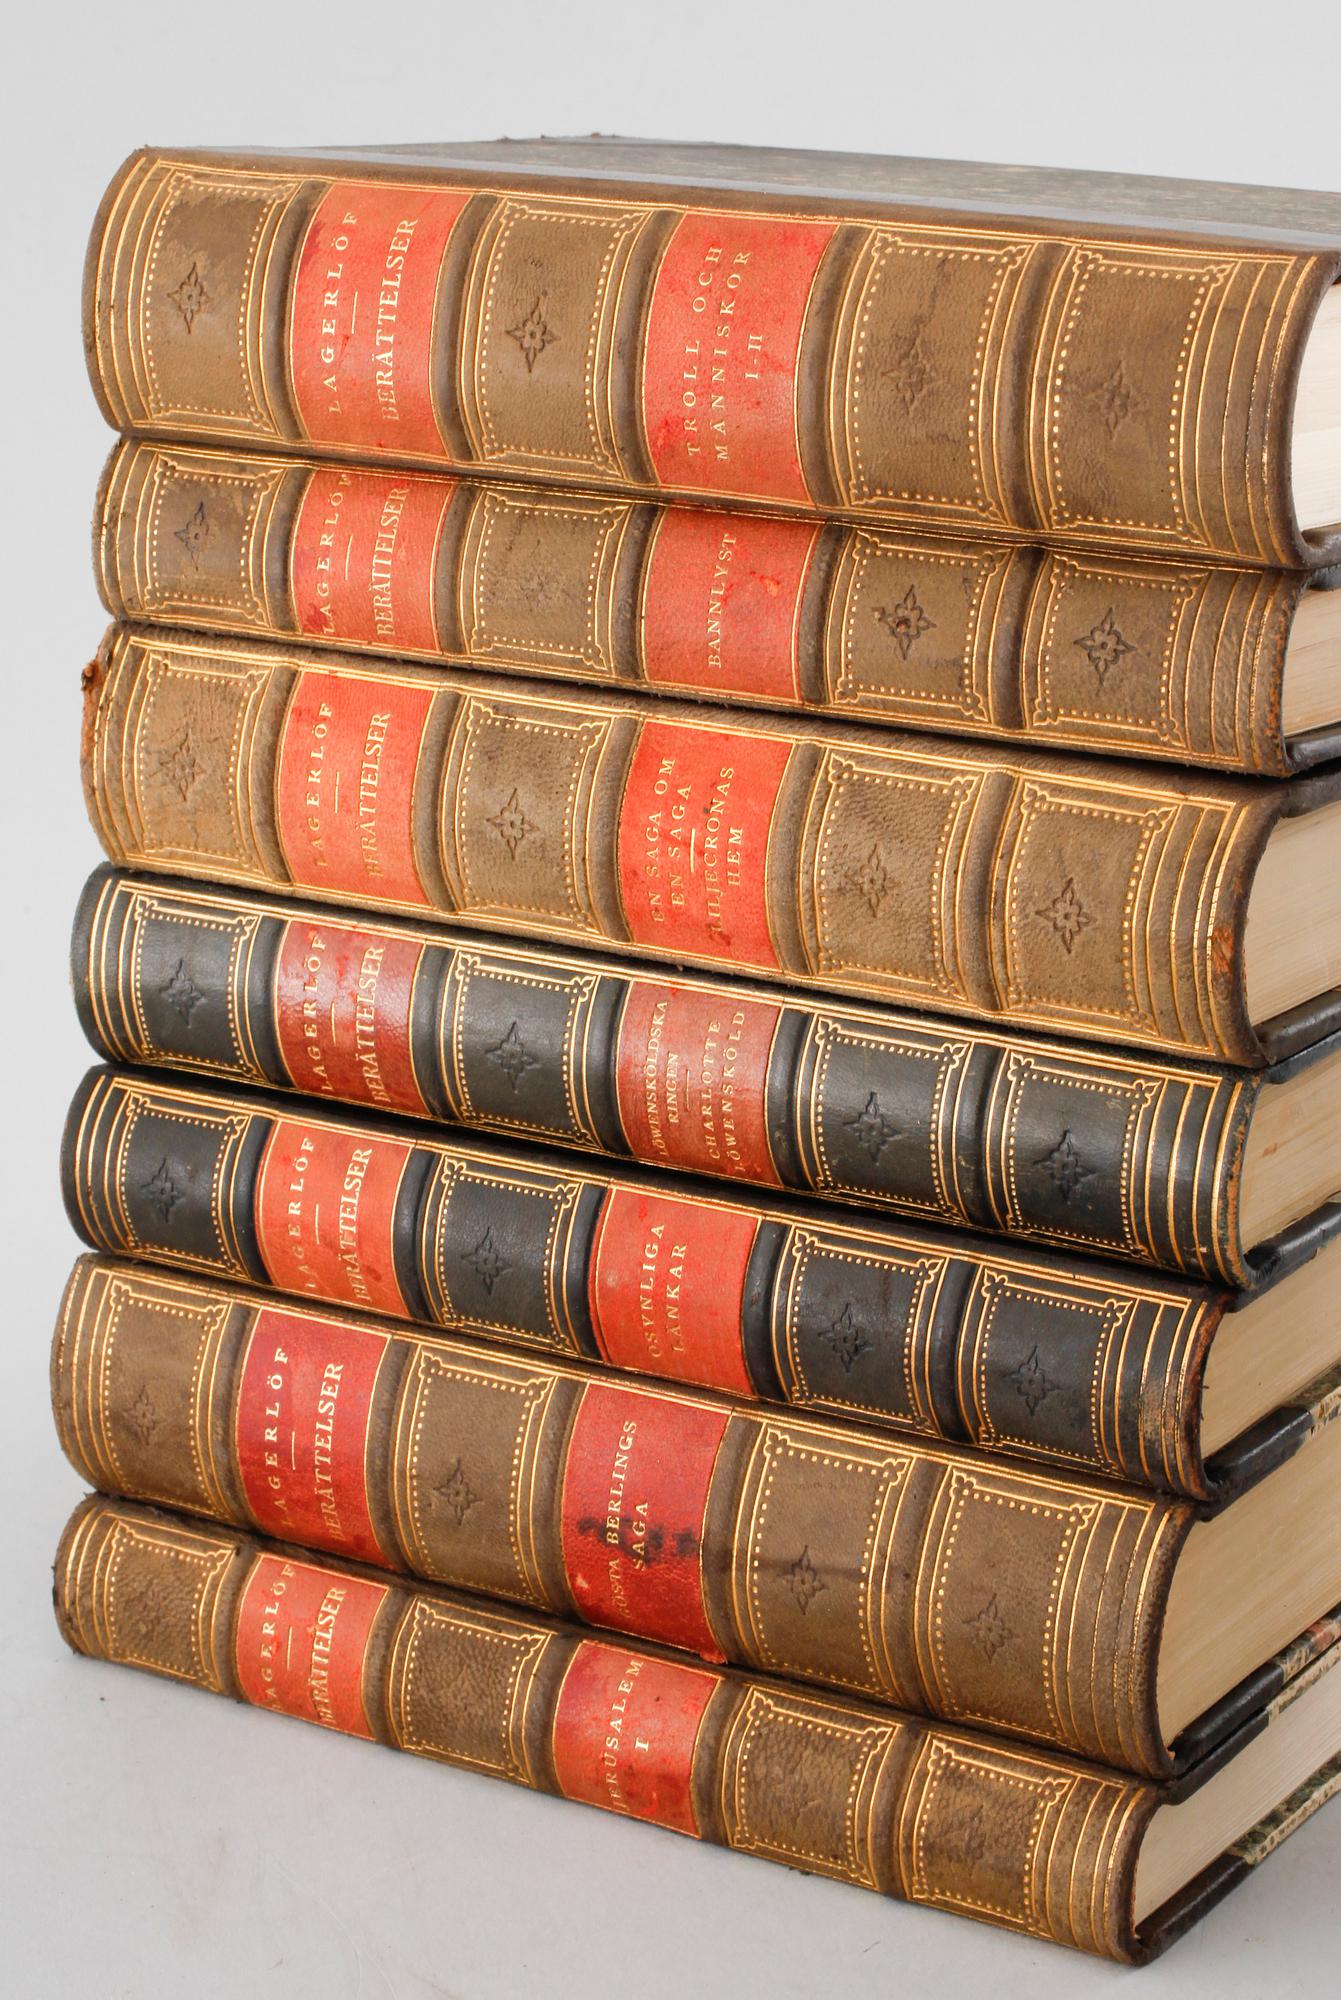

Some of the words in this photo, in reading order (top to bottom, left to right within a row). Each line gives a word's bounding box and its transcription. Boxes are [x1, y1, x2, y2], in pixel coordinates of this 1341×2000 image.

[320, 212, 358, 415] LAGERLÖF
[372, 218, 418, 420] BERÄTTELSER
[683, 340, 701, 456] TROLL
[692, 246, 722, 312] OCH
[709, 251, 751, 461] MÄNNISKOR
[369, 488, 410, 635] BERÄTTELSER
[707, 533, 736, 668] BANNLYST
[646, 811, 662, 877] SAGA
[654, 758, 675, 795] OM
[668, 785, 692, 858] SAGA
[648, 891, 665, 922] EN
[669, 872, 685, 906] EN
[704, 767, 734, 931] LILJECRONAS
[728, 826, 743, 885] HEM
[303, 934, 334, 1092] LAGERLÖF
[355, 946, 391, 1103] BERÄTTELSER
[643, 1001, 668, 1156] LÖWENSKÖLDSKA
[666, 1051, 680, 1124] RINGEN
[701, 1020, 721, 1159] CHARLOTTE
[721, 1011, 746, 1171] LÖWENSKÖLD
[666, 1243, 686, 1353] LÄNKAR
[314, 1363, 347, 1541] BERÄTTELSER
[606, 1420, 637, 1545] BERLINGS
[632, 1502, 649, 1571] SAGA
[603, 1659, 644, 1811] JERUSALEM
[635, 1736, 649, 1752] I
